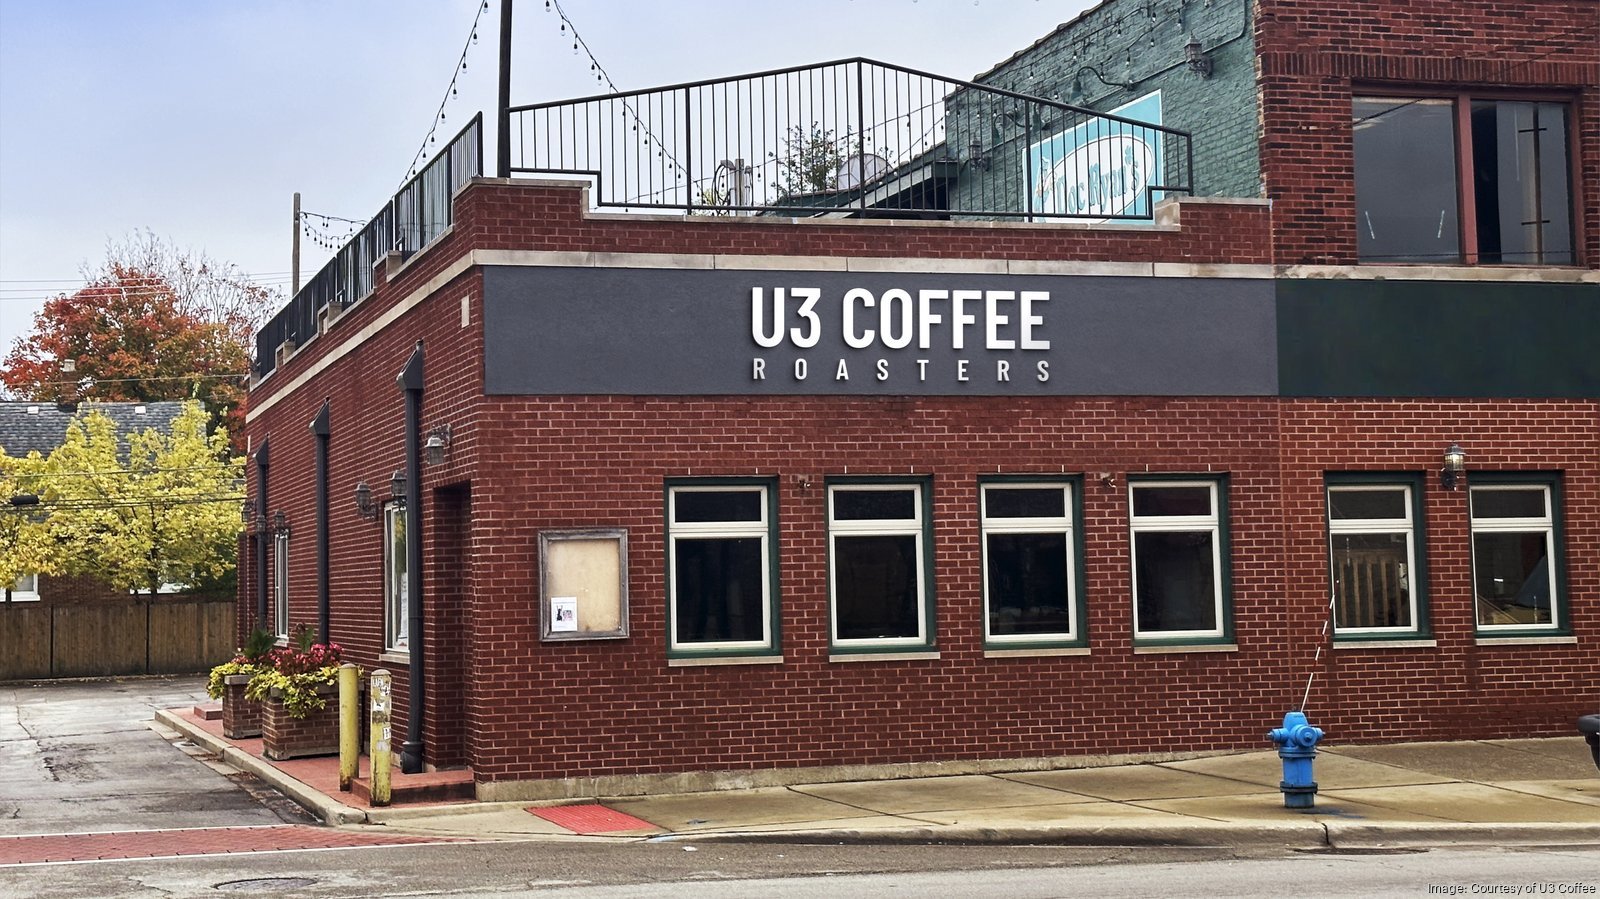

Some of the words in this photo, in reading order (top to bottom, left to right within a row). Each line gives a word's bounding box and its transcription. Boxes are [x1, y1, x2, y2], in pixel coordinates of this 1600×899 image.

[751, 286, 822, 349] U3
[842, 287, 1051, 350] COFFEE
[752, 358, 1050, 382] ROASTERS
